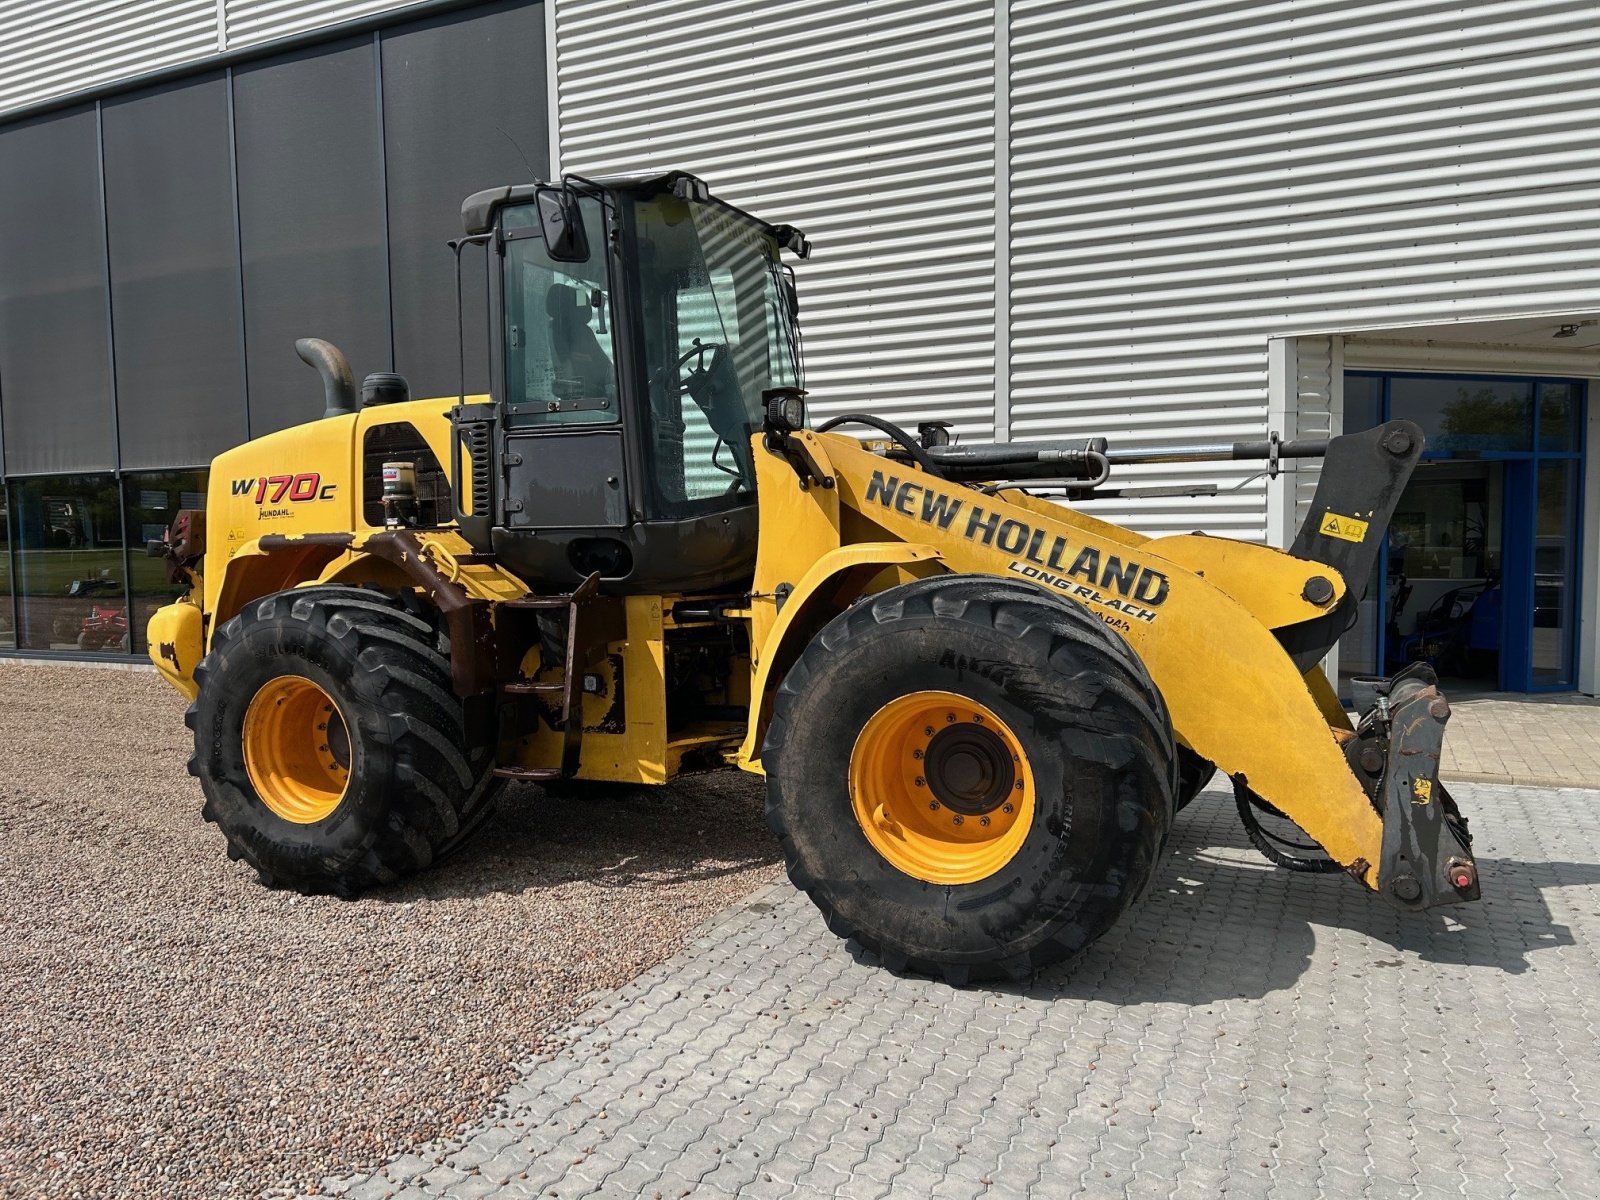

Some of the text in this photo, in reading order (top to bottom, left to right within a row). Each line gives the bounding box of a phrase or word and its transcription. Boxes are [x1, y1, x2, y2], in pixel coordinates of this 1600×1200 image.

[864, 469, 1170, 607] NEW HOLLAND
[1008, 561, 1158, 622] LONG REACH
